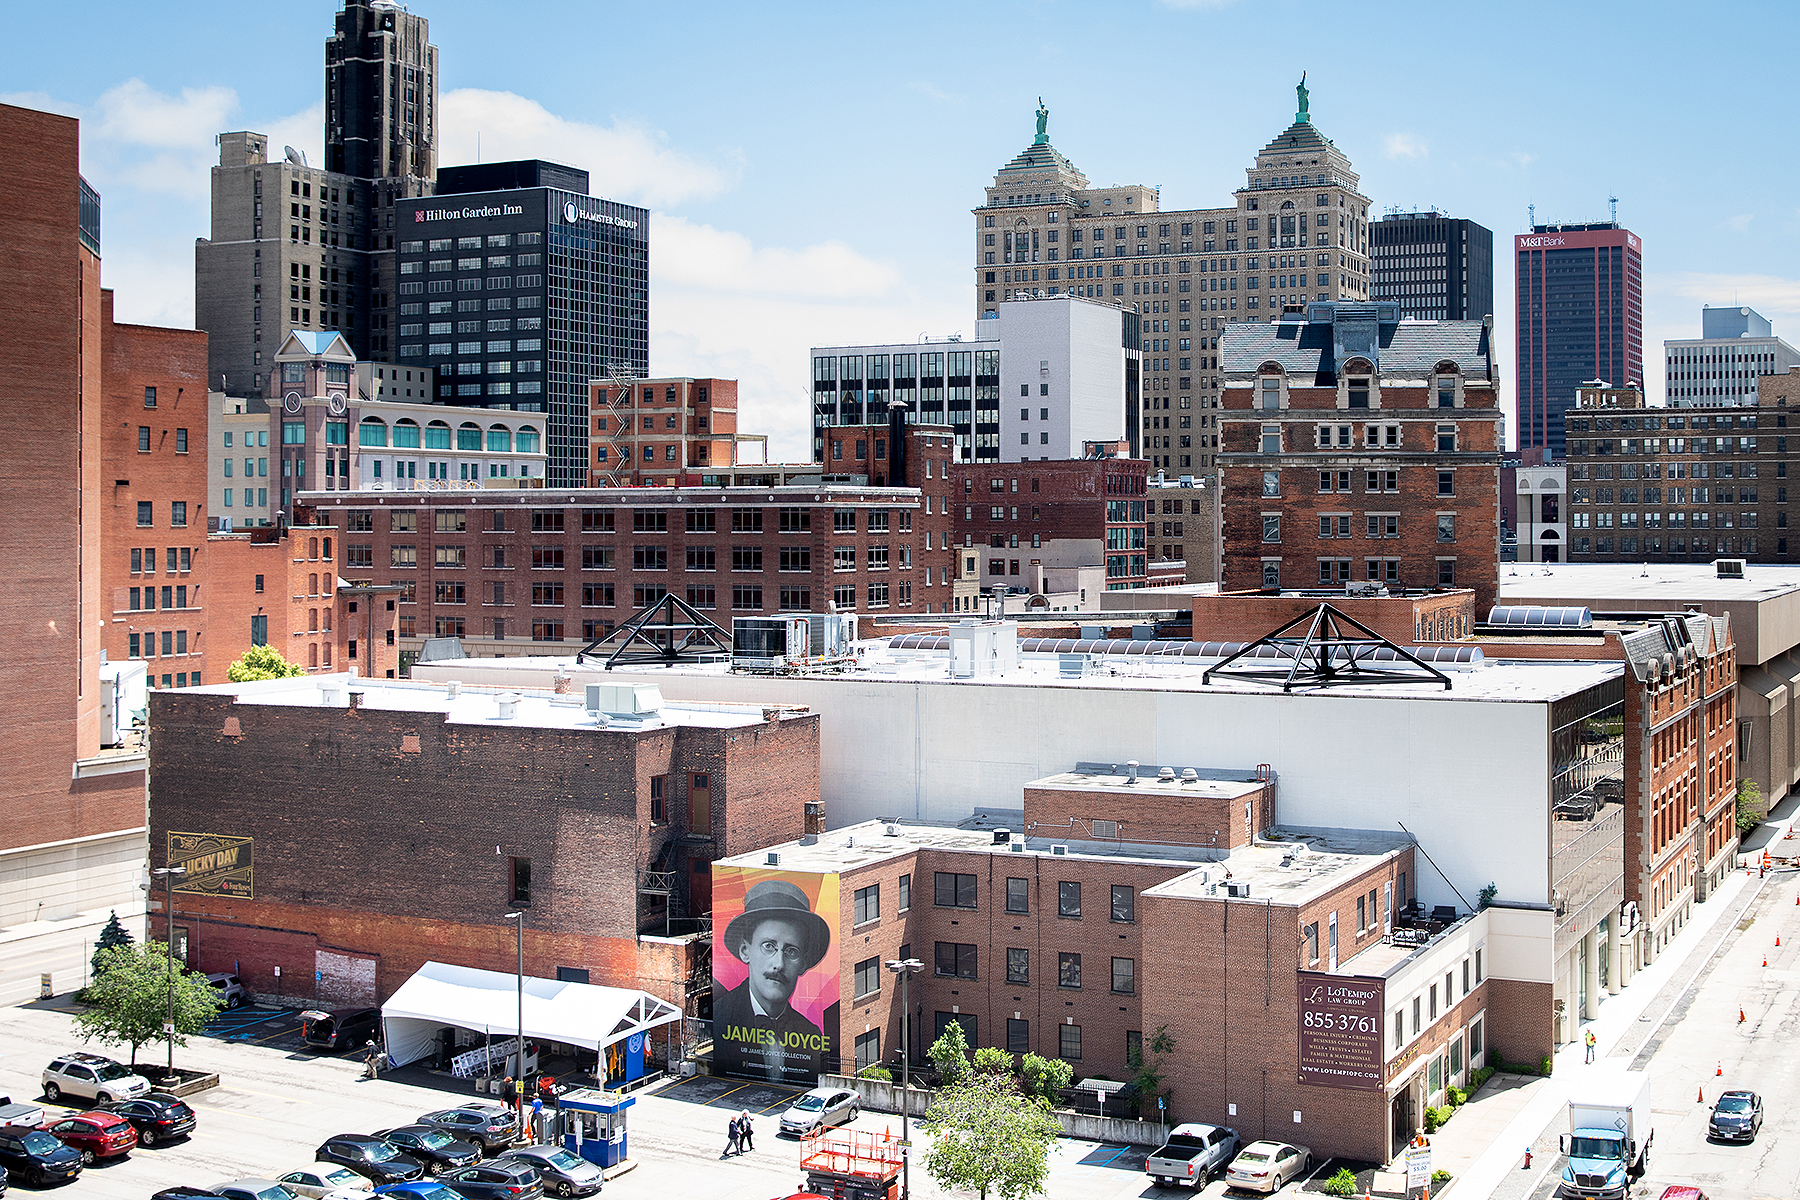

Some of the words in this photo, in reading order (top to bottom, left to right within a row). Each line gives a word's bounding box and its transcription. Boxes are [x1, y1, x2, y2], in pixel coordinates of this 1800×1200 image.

[426, 209, 461, 221] Hilton
[462, 206, 501, 218] Garden
[503, 204, 522, 215] Inn
[614, 216, 638, 229] GROUP
[1520, 237, 1543, 248] M&T
[1543, 236, 1565, 247] Bank
[216, 847, 239, 867] DAY
[722, 1025, 775, 1046] JAMES
[779, 1031, 831, 1052] JOYCE
[1352, 1034, 1378, 1042] CRIMINAL
[780, 1051, 811, 1060] COLLECTION
